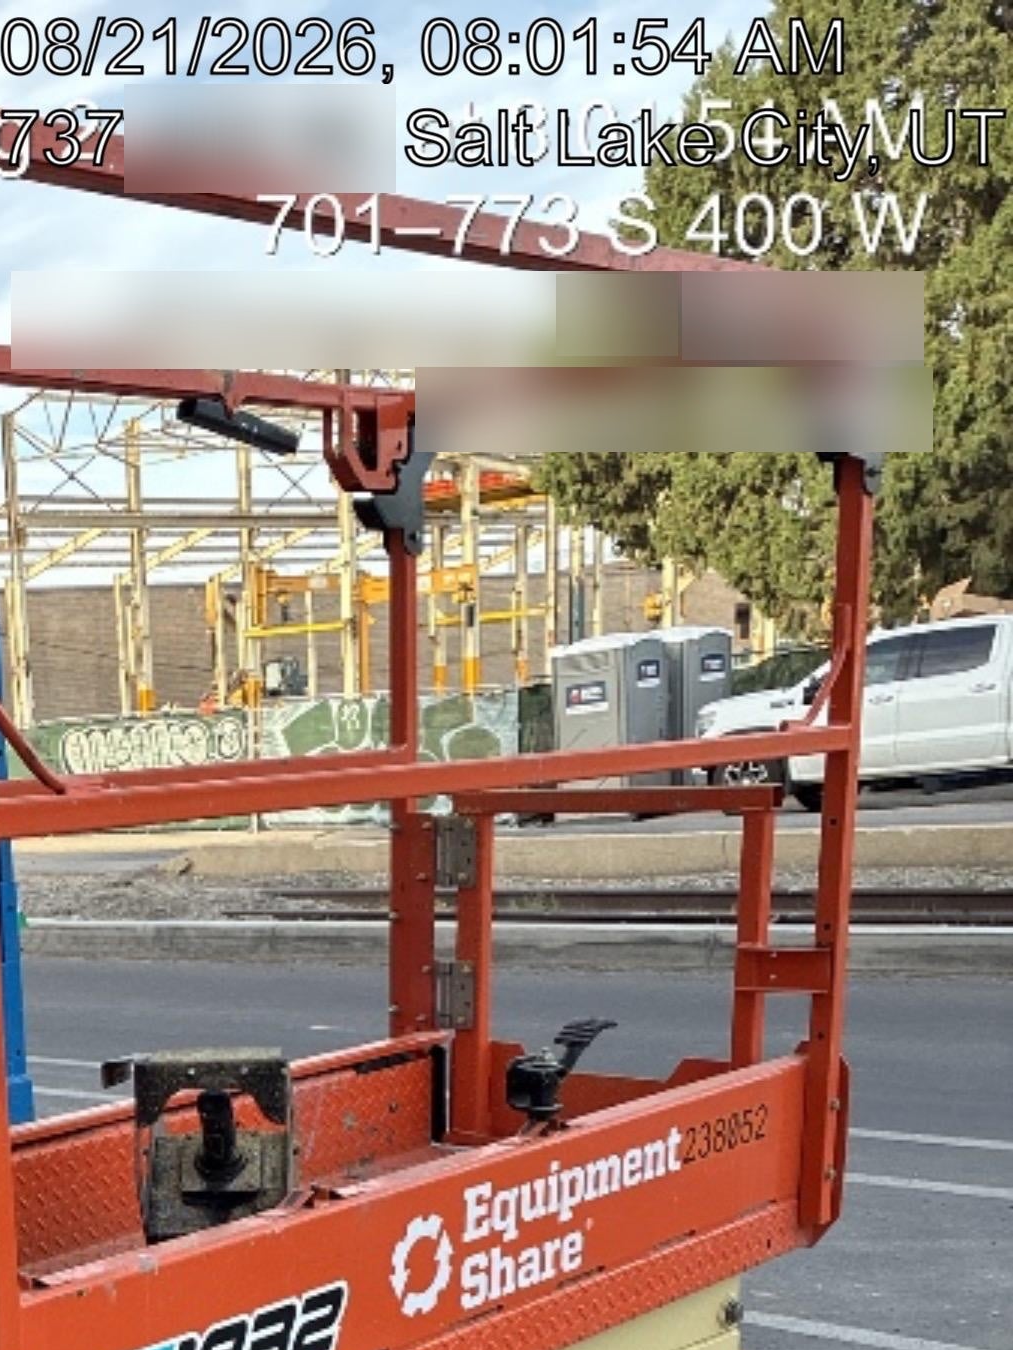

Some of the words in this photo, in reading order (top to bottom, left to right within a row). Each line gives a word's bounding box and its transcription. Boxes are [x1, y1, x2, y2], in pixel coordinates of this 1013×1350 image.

[683, 1104, 768, 1164] 238052
[462, 1127, 684, 1242] Equipment
[460, 1231, 584, 1310] Share
